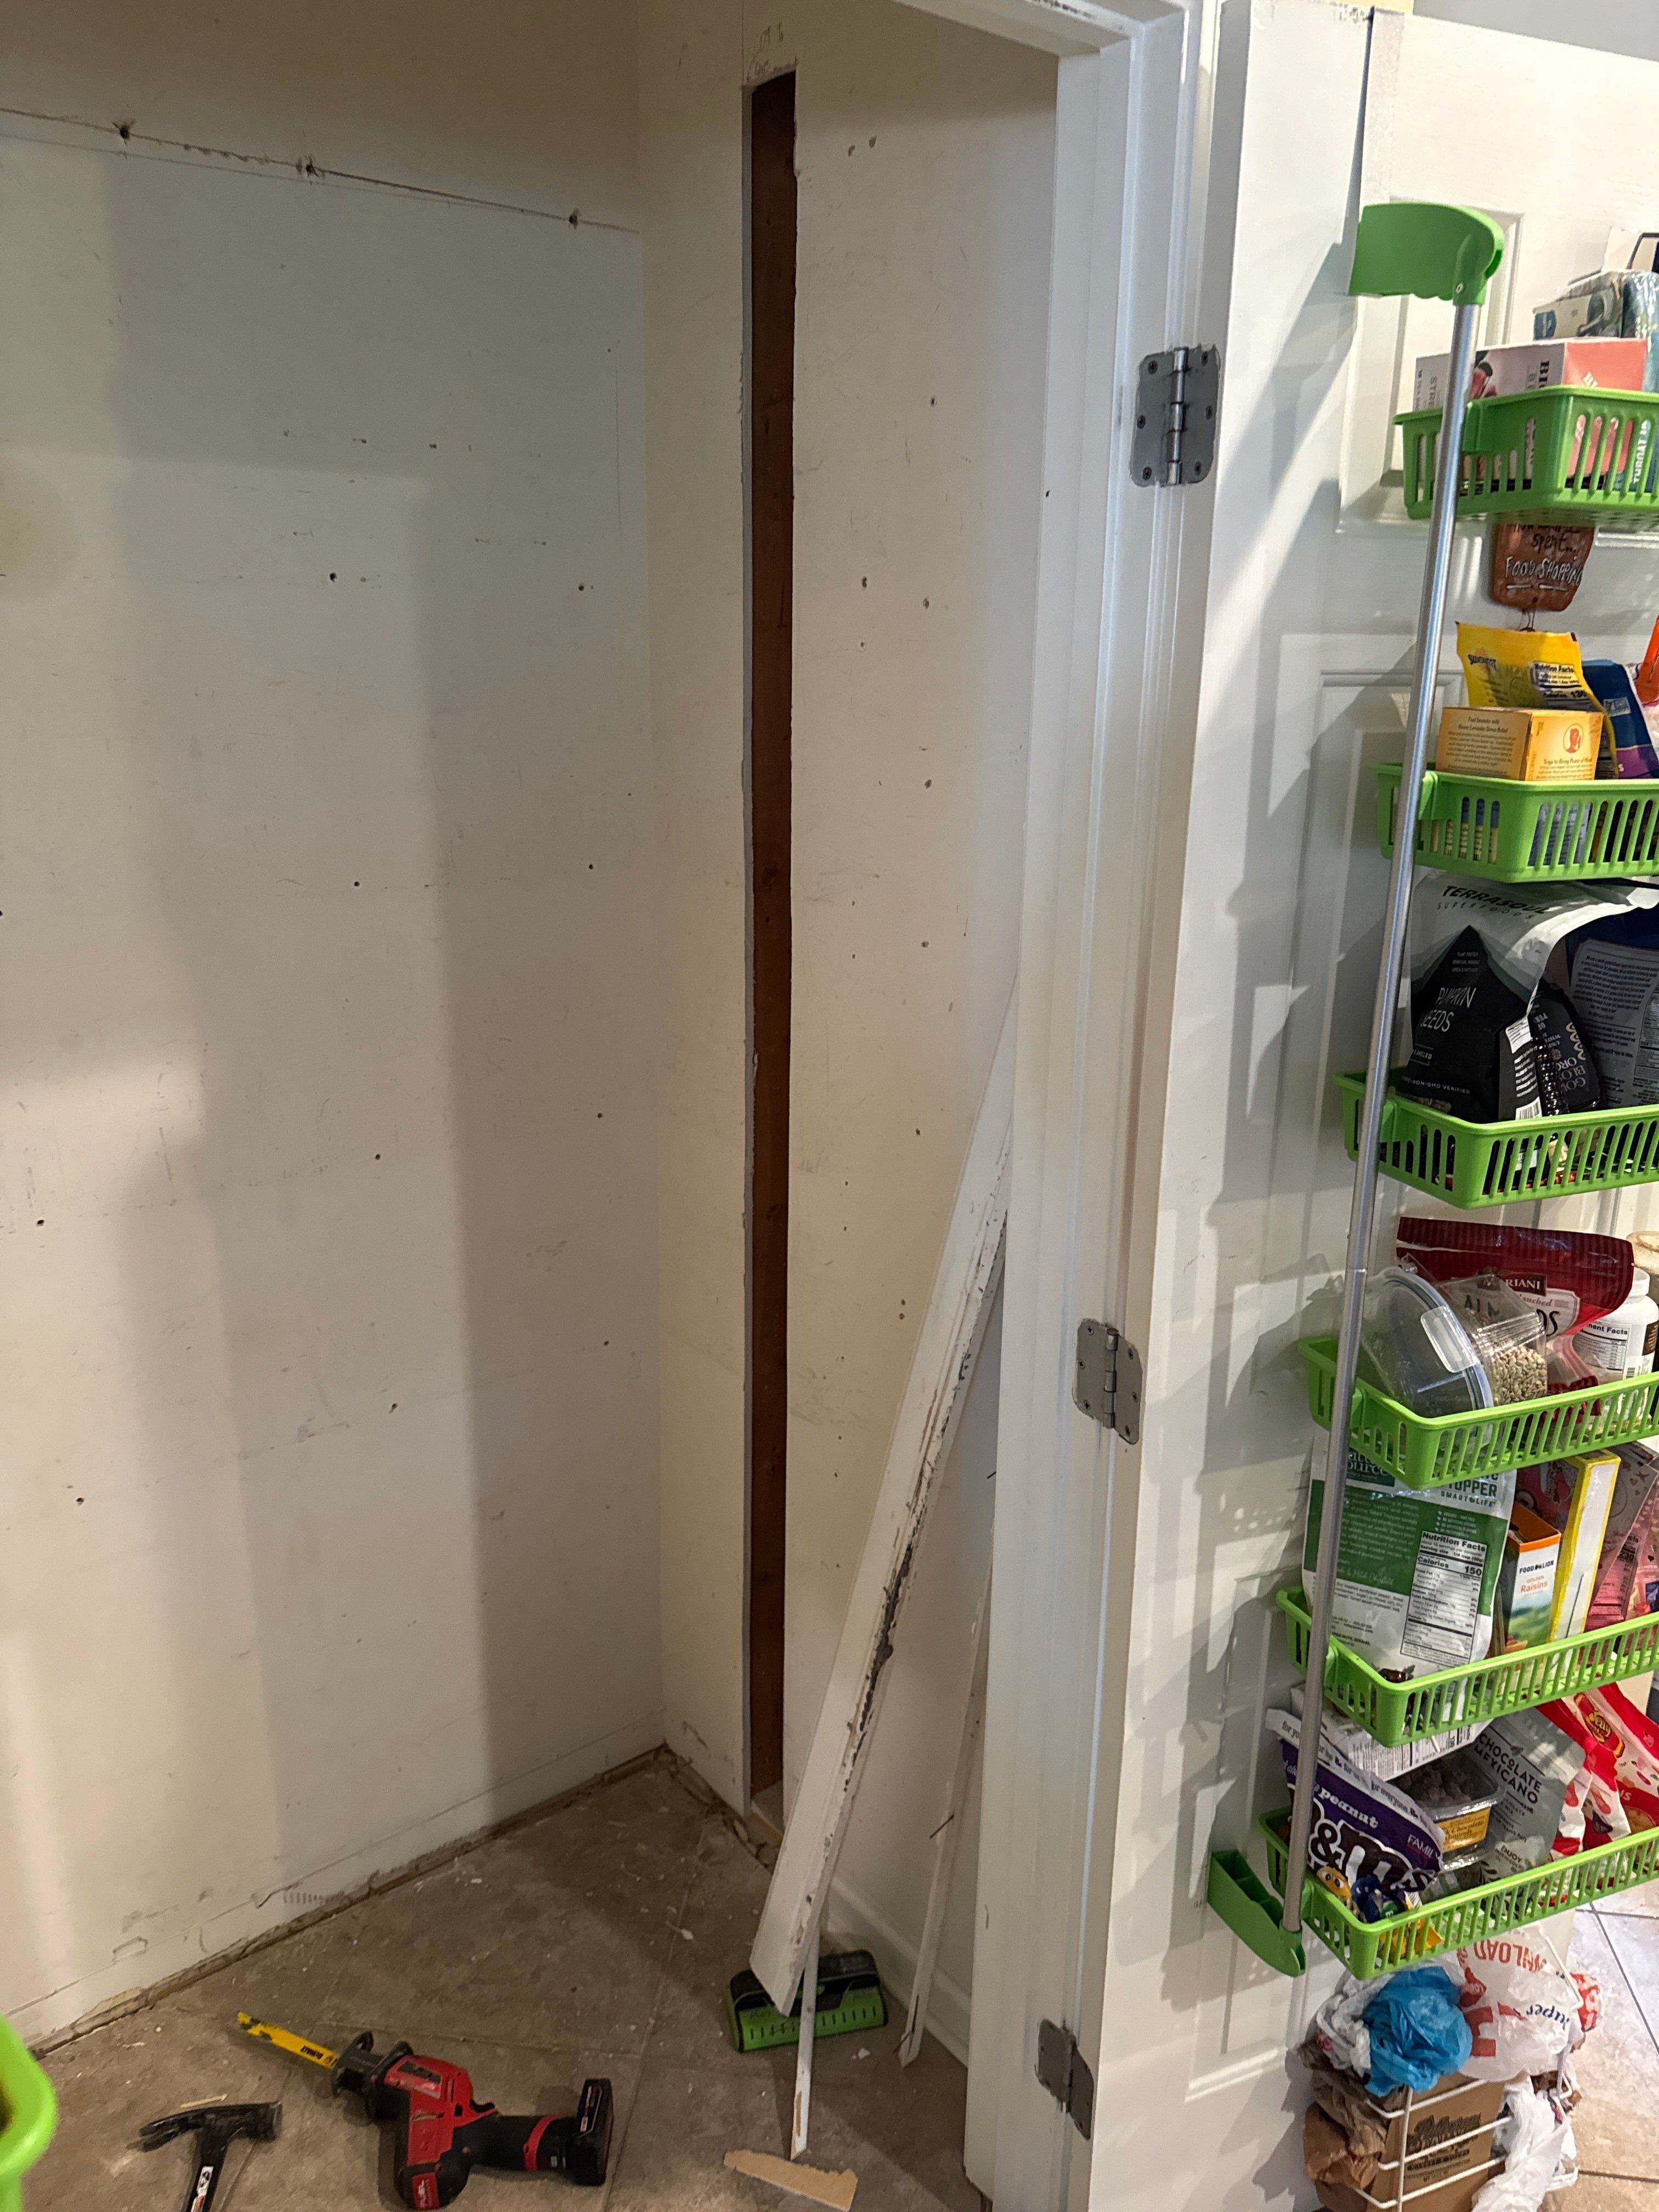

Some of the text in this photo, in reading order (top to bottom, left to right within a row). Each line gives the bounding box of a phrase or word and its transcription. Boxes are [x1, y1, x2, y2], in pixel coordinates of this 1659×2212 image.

[1505, 556, 1584, 587] FOOD SHOPPIN
[1442, 885, 1549, 914] TERRASOUL
[1437, 901, 1534, 919] SUPERFOODS
[1420, 1009, 1454, 1032] EEDS
[1506, 1278, 1541, 1290] RIANI
[1606, 1327, 1628, 1335] Facts
[1441, 1490, 1469, 1503] SMART
[1422, 1532, 1486, 1551] Nutrition Facts
[1418, 1556, 1482, 1576] Calories 150
[1519, 1560, 1554, 1574] FOOD LION
[1520, 1581, 1548, 1593] Raisins
[1479, 1733, 1542, 1793] CHOCOLATE
[1318, 1787, 1379, 1829] peanut
[1500, 1845, 1522, 1863] ENJOY
